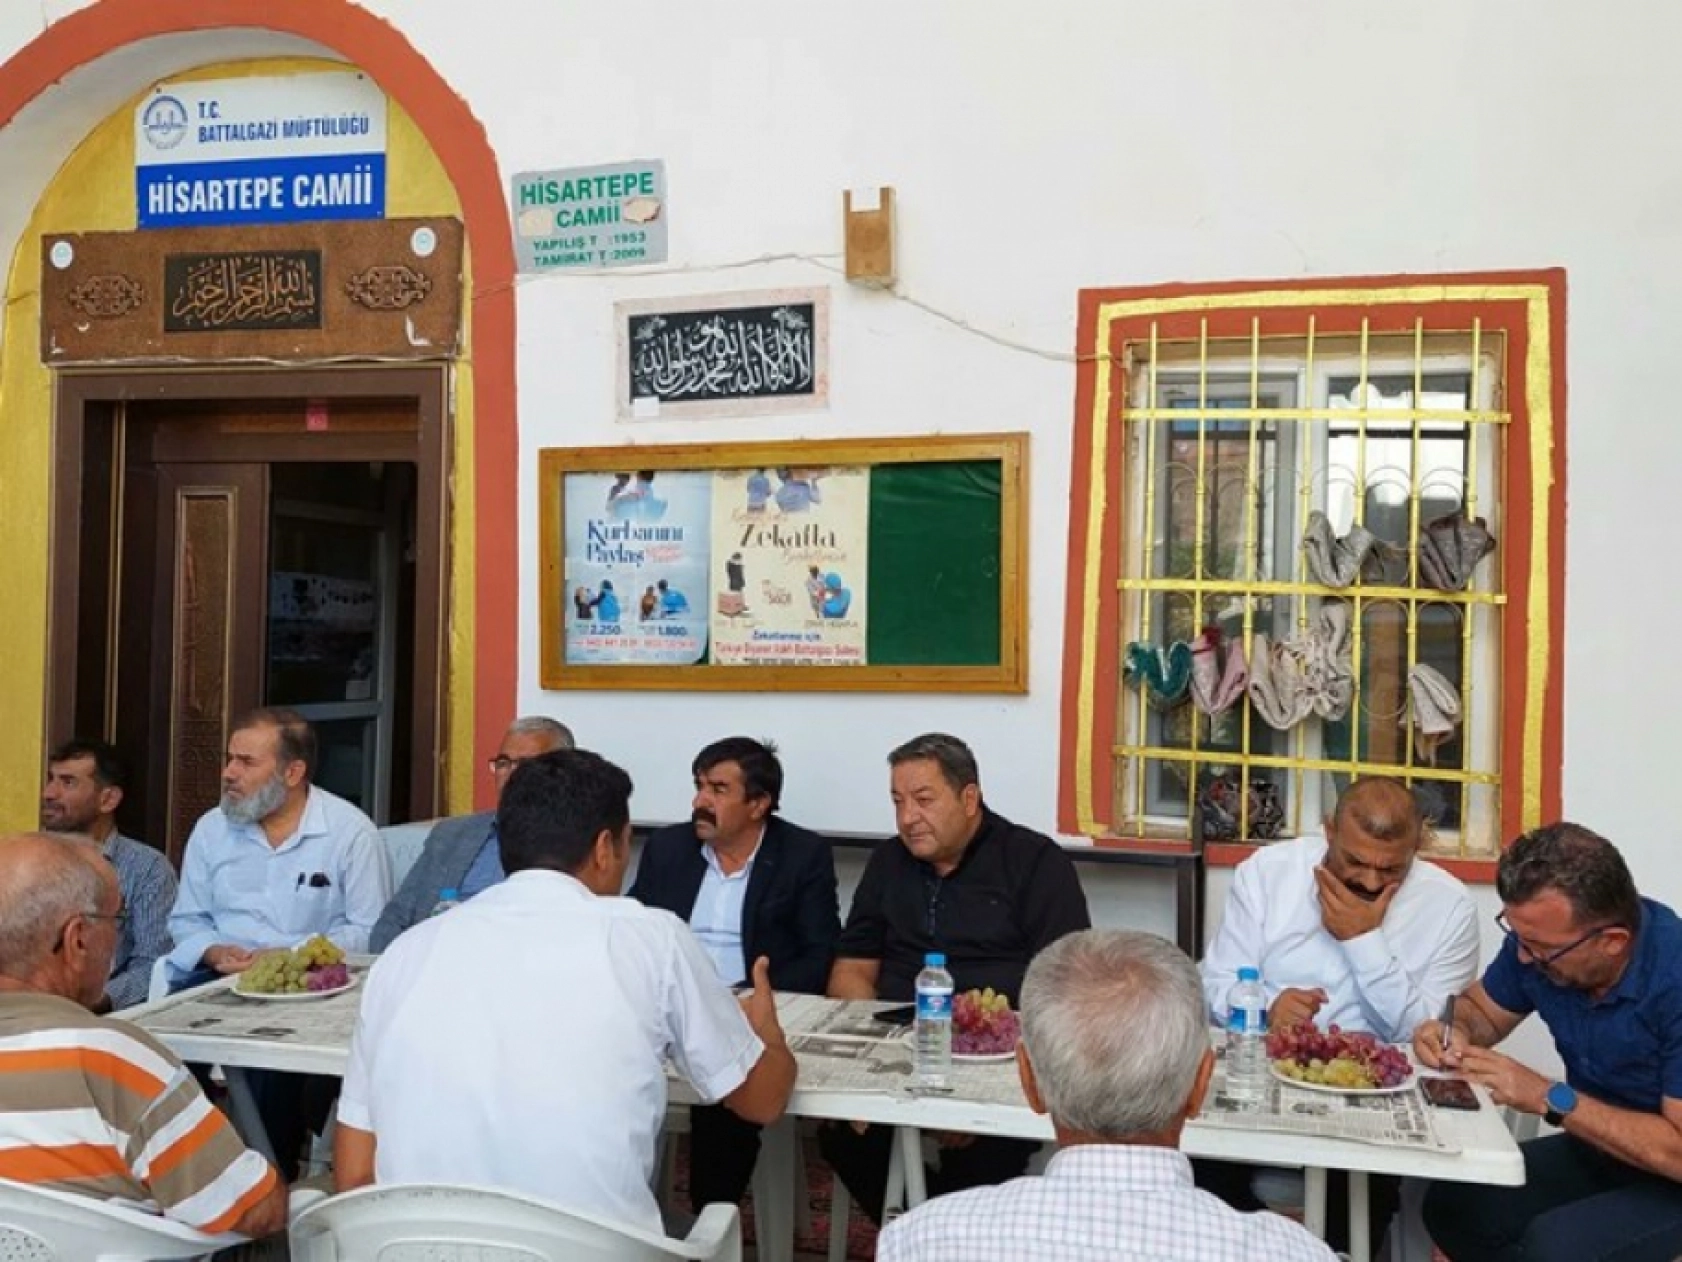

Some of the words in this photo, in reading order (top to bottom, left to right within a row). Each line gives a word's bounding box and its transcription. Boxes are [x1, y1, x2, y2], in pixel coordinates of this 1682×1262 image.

[198, 101, 221, 119] T.C.
[198, 117, 277, 143] BATTALGAZİ
[282, 111, 370, 138] MÜFTÜLÜĞÜ
[148, 175, 284, 215] HİSARTEPE
[292, 165, 372, 207] CAMİİ
[520, 173, 654, 205] HİSARTEPE
[556, 201, 621, 228] CAMİİ
